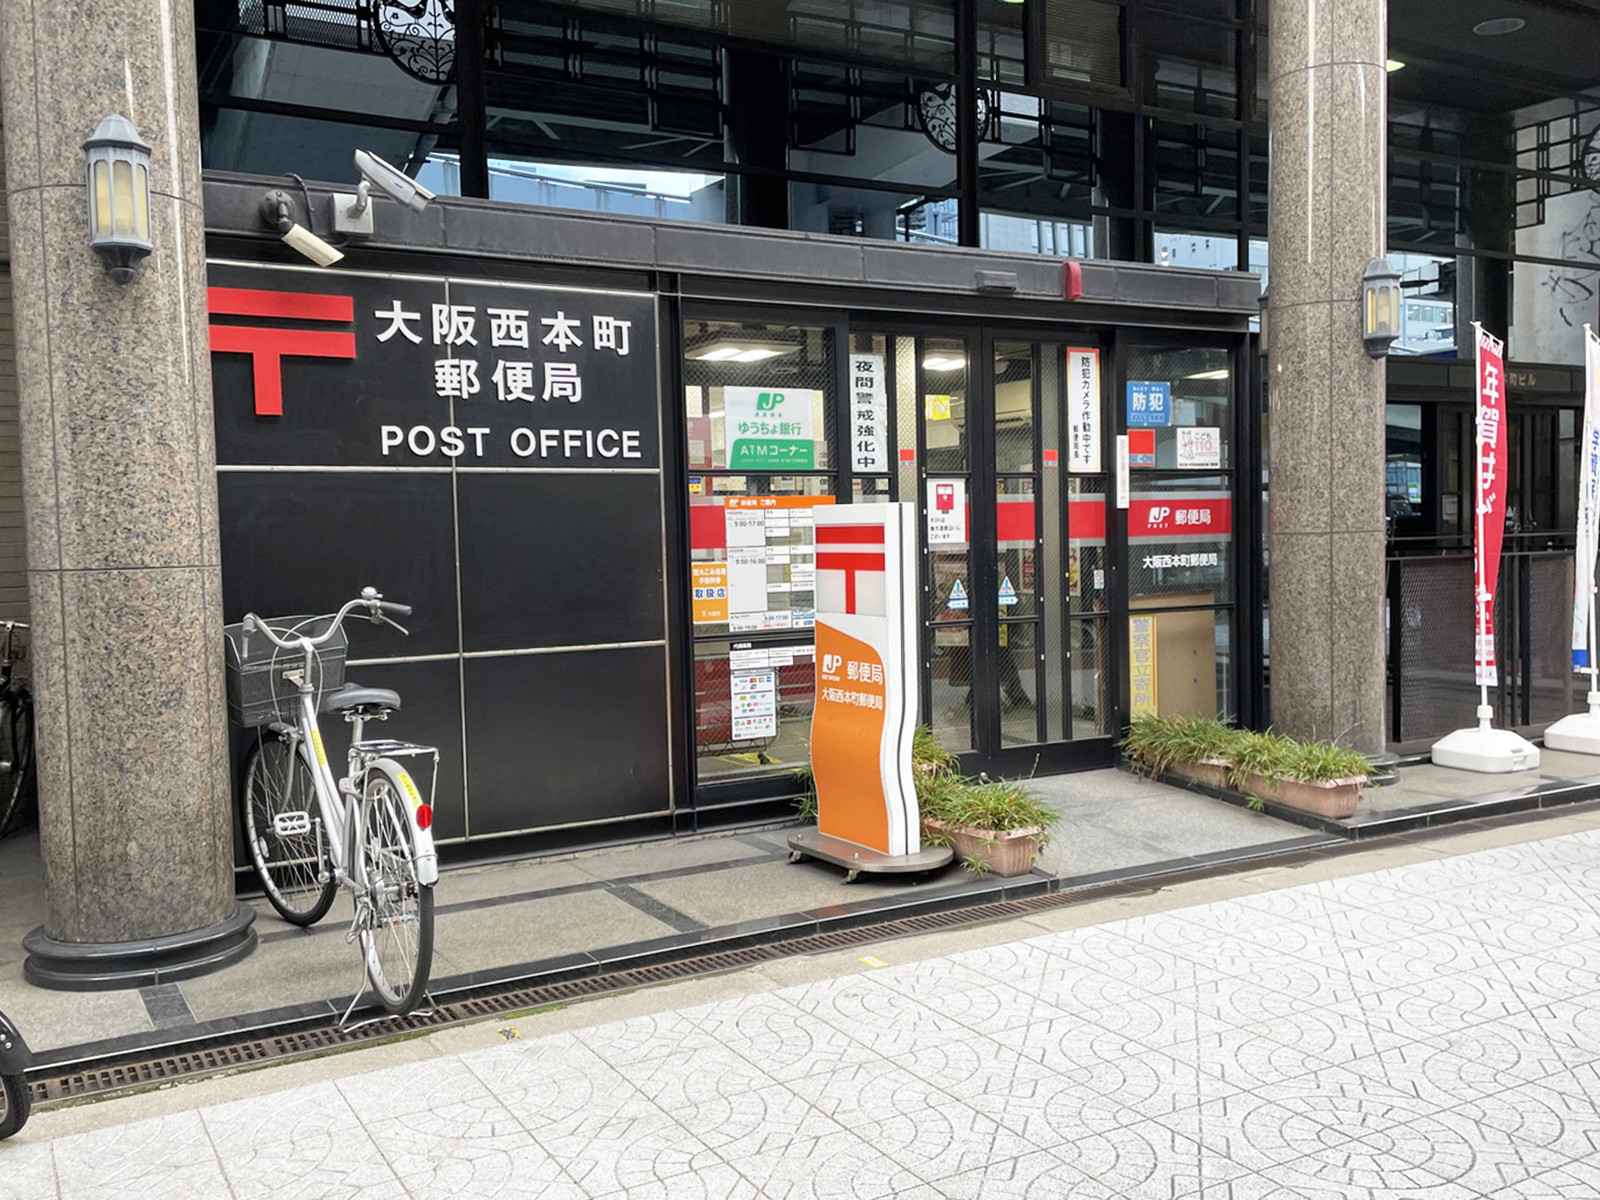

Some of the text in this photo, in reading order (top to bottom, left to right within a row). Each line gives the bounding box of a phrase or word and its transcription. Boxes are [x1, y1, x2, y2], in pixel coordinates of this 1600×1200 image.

[374, 300, 632, 356] 大阪西本町
[434, 358, 583, 403] 郵便局
[756, 392, 785, 411] JP
[1081, 356, 1092, 466] 防犯カメラ作動中です
[1132, 392, 1164, 411] 防犯
[855, 360, 876, 468] 夜間警戒強化中
[738, 421, 802, 436] ゆうちょ銀行
[381, 425, 642, 459] POST OFFICE
[740, 445, 808, 456] ATMコーナー
[1148, 507, 1170, 523] JP
[1174, 509, 1211, 525] 郵便局
[1142, 553, 1218, 569] 大阪西本町郵便局
[694, 588, 726, 598] 取扱店
[822, 654, 842, 673] JP
[847, 660, 883, 685] 郵便局
[822, 686, 883, 710] 大阪西本町郵便局
